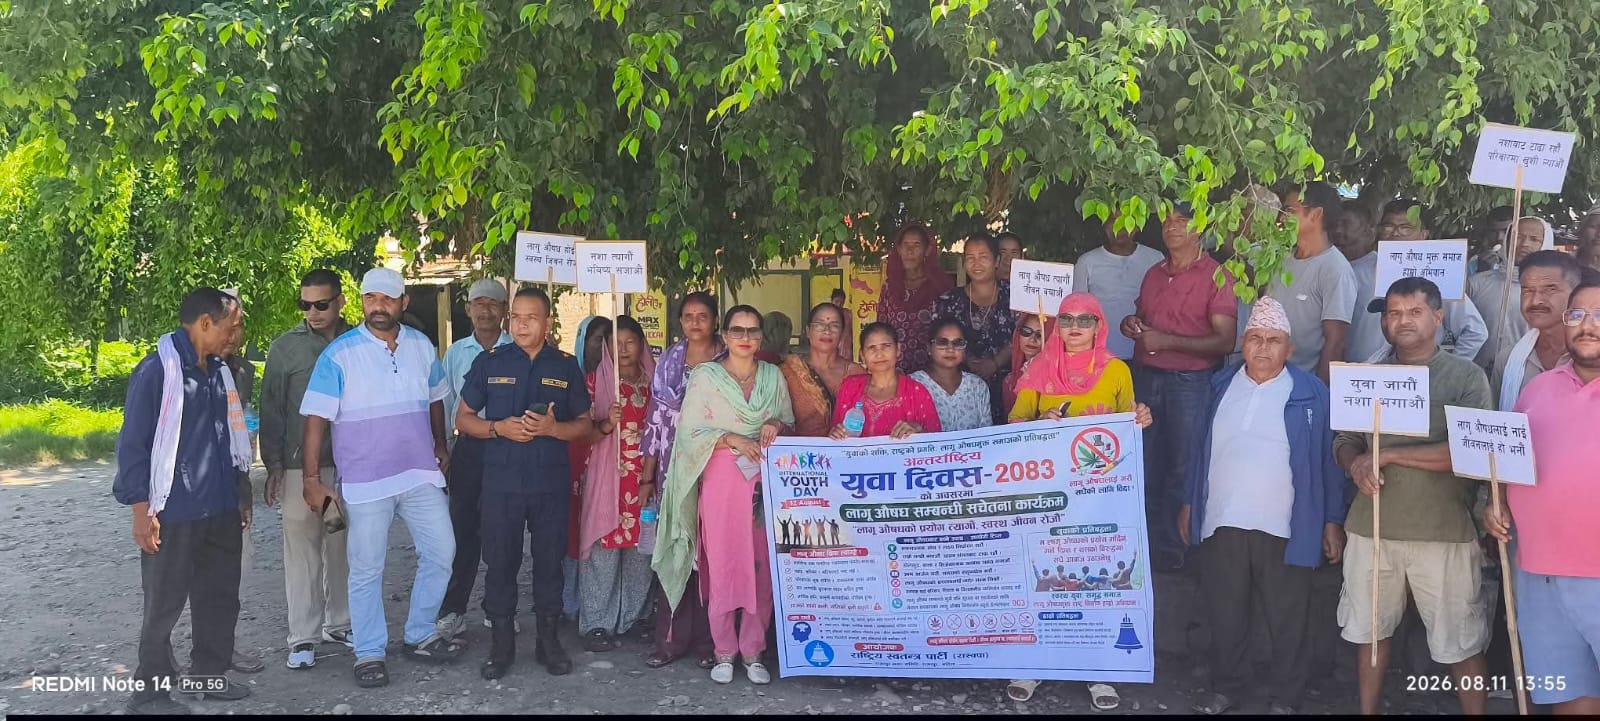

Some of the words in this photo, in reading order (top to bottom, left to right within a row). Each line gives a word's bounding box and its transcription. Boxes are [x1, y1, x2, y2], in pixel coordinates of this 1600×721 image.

[590, 252, 607, 261] नशा
[1442, 253, 1462, 262] समाज
[1350, 380, 1376, 392] युवा
[1384, 377, 1418, 391] जागौं
[1344, 396, 1372, 407] नशा
[1379, 395, 1425, 409] भगाऔं
[780, 477, 828, 487] YOUTH
[840, 471, 896, 498] युवा
[794, 487, 818, 497] DAY
[920, 492, 932, 500] को
[845, 506, 873, 522] लागू
[875, 504, 909, 519] औषध
[913, 502, 963, 518] सम्बन्धी
[966, 499, 1012, 514] सचेतना
[1015, 495, 1064, 510] कार्यक्रम
[879, 523, 916, 533] औषधको
[920, 522, 944, 532] प्रयोग
[981, 520, 1007, 529] स्वस्थ
[1011, 516, 1036, 526] जीवन
[850, 651, 882, 661] राष्ट्रिय
[886, 652, 921, 660] स्वतन्त्र
[926, 651, 947, 660] पार्टी
